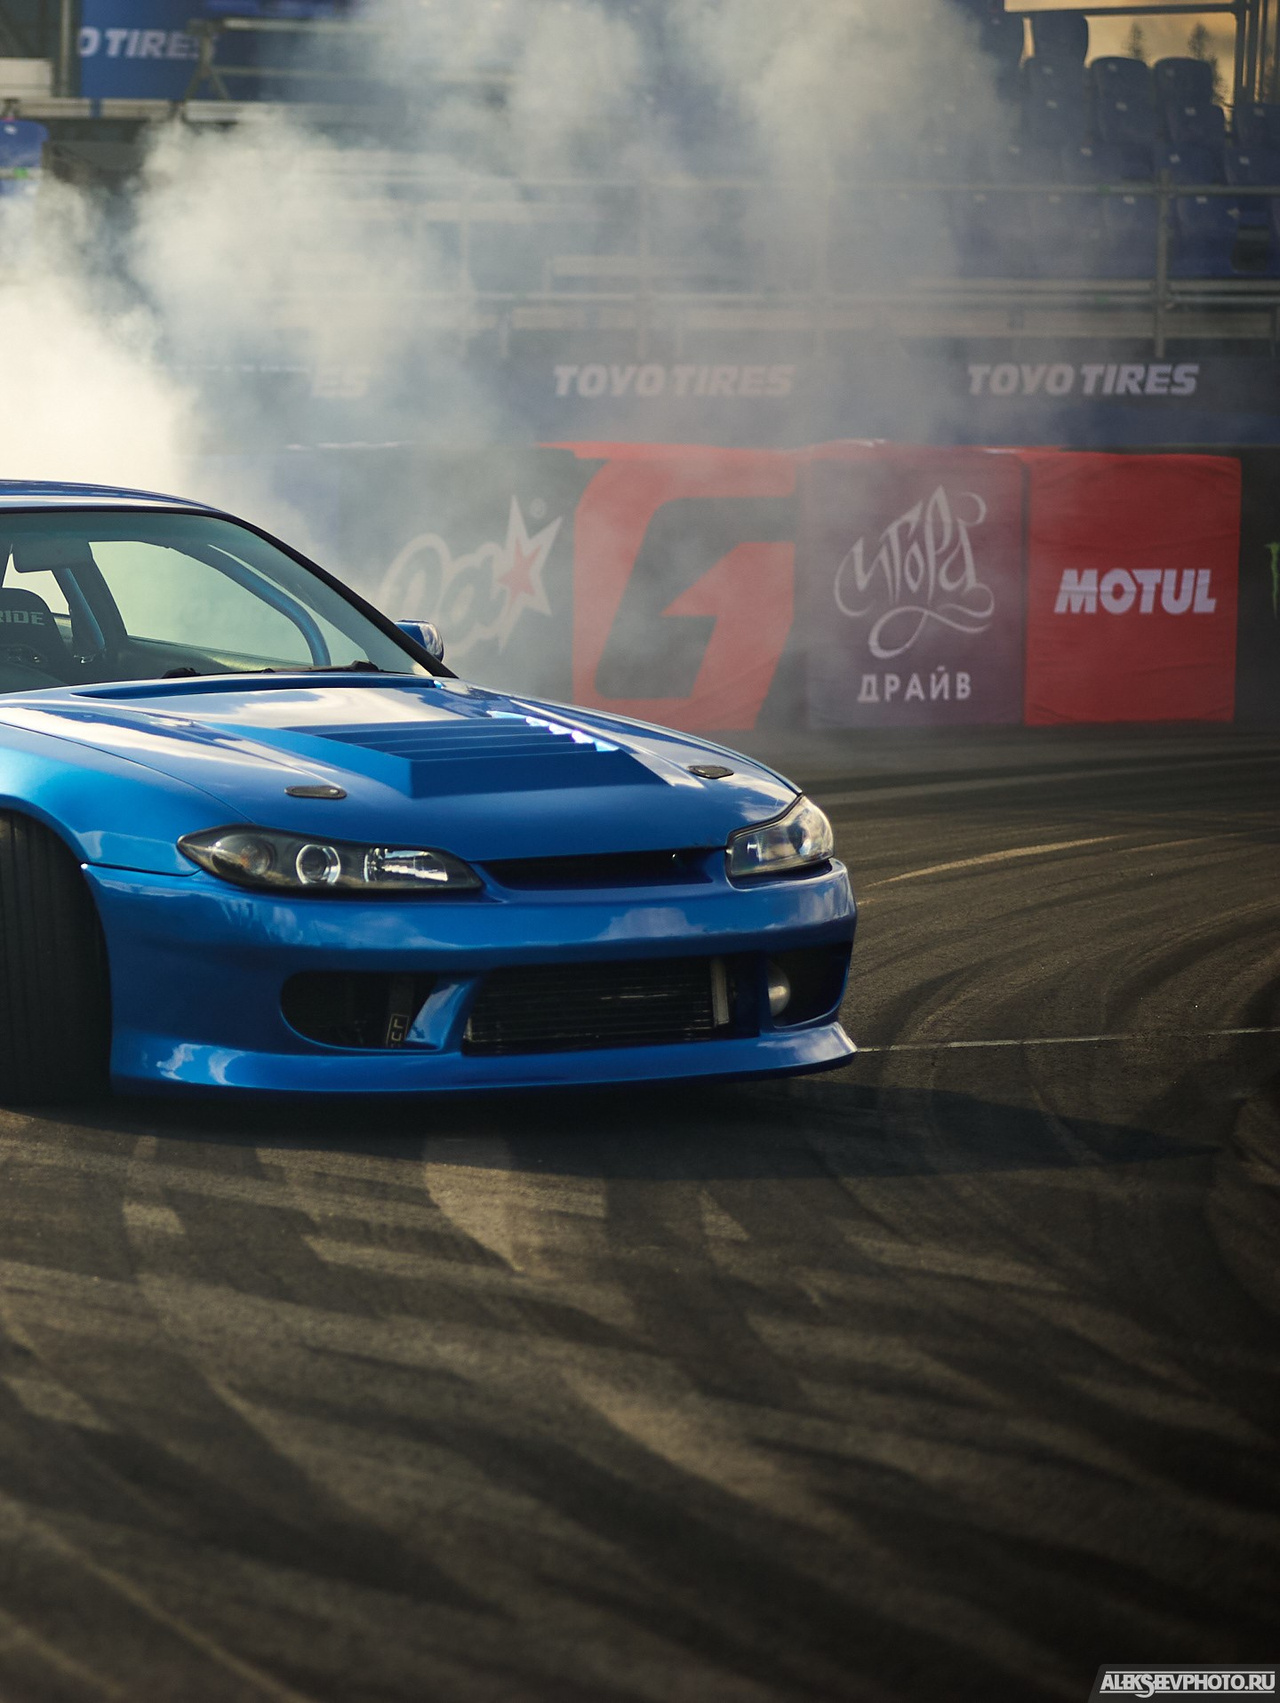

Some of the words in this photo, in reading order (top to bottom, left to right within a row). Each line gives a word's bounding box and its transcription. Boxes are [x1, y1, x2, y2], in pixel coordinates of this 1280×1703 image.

[553, 363, 667, 398] TOYO
[670, 363, 798, 398] TIRES
[968, 363, 1075, 396] TOYO
[1080, 363, 1200, 396] TIRES
[1054, 568, 1217, 615] MOTUL
[857, 666, 971, 703] ДРАЙВ
